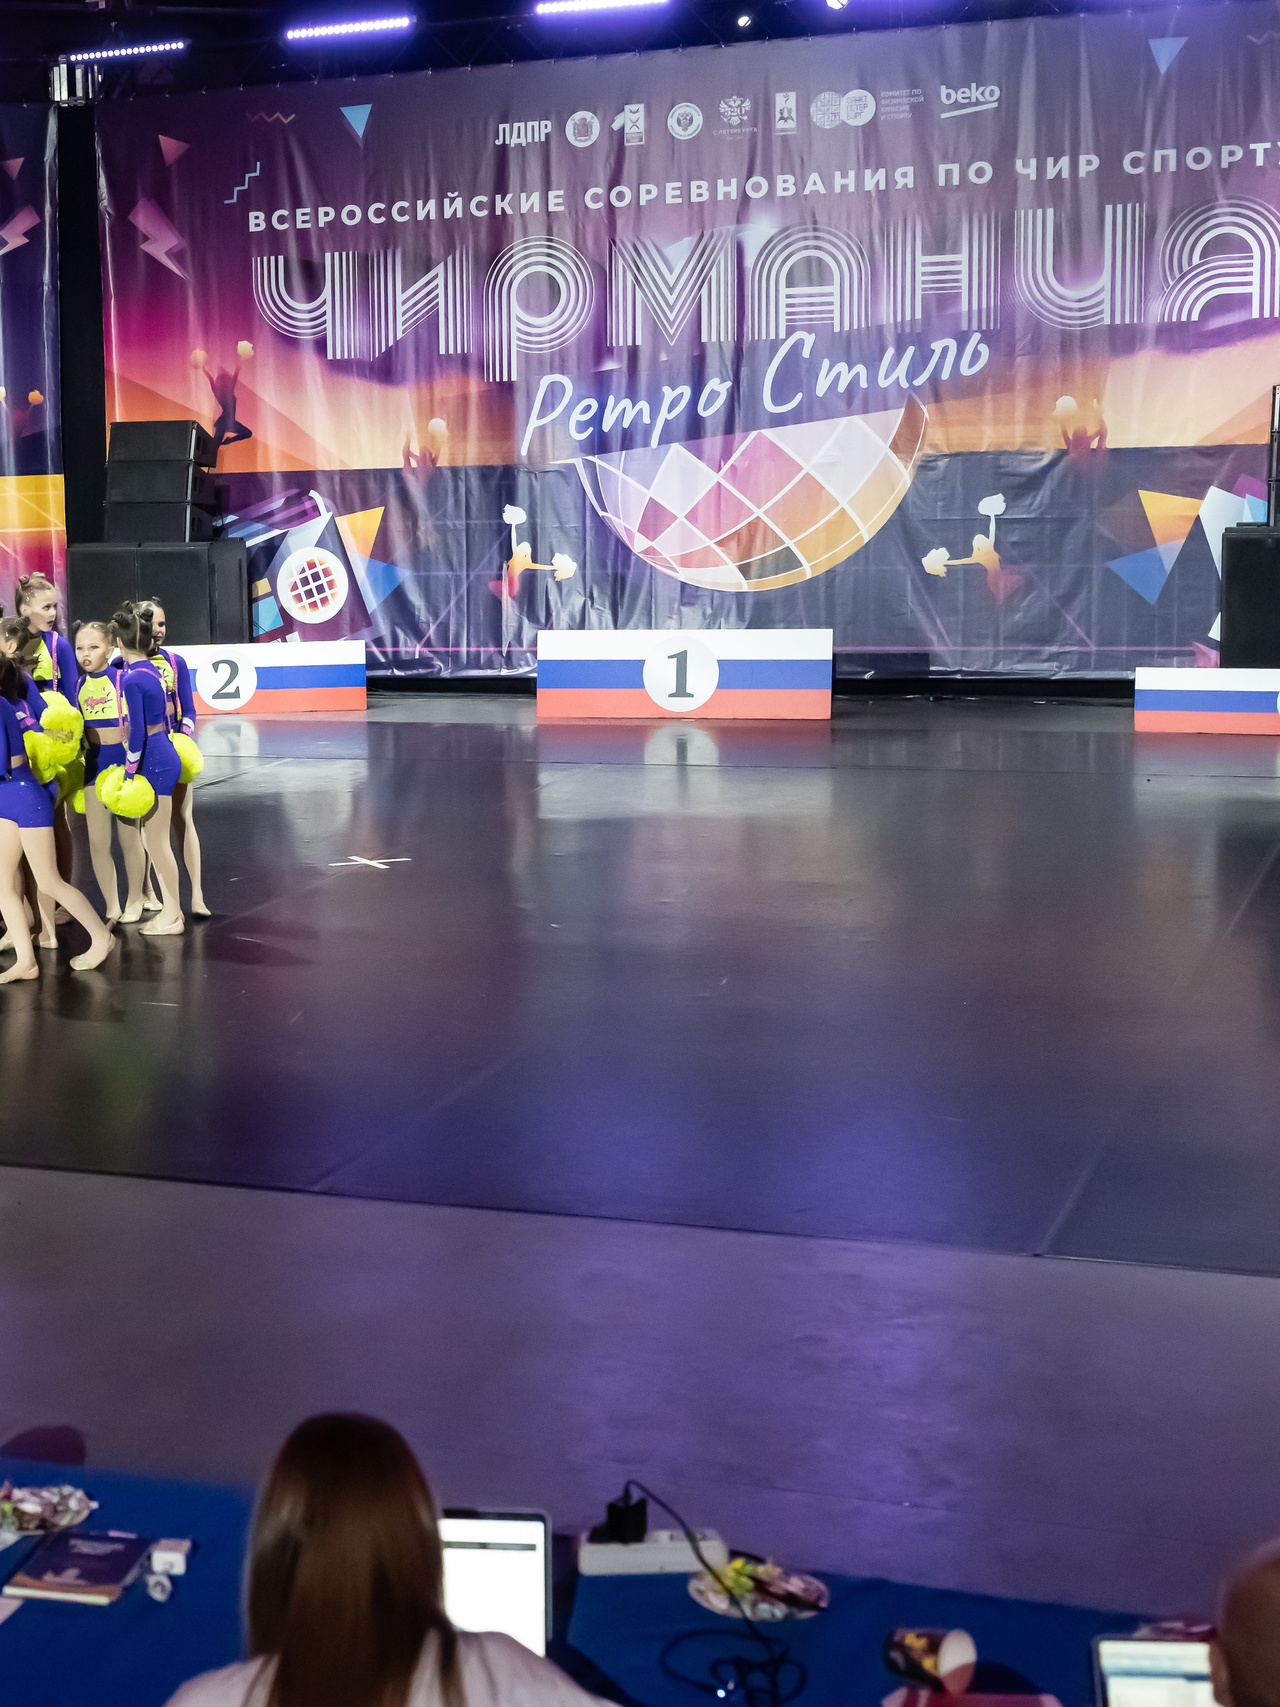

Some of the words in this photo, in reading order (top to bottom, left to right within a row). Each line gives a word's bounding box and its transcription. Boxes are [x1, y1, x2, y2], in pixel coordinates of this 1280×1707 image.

[940, 82, 1001, 105] beko
[494, 120, 552, 147] ЛДПР
[249, 188, 565, 233] ВСЕРОССИЙСКИЕ
[584, 164, 916, 208] СОРЕВНОВАНИЯ
[937, 161, 994, 187] ПО
[1015, 154, 1101, 181] ЧИР
[1122, 141, 1280, 175] СПОРТ
[520, 373, 733, 456] Ретро
[762, 331, 990, 412] Стиль
[210, 658, 242, 700] 2
[666, 648, 696, 699] 1
